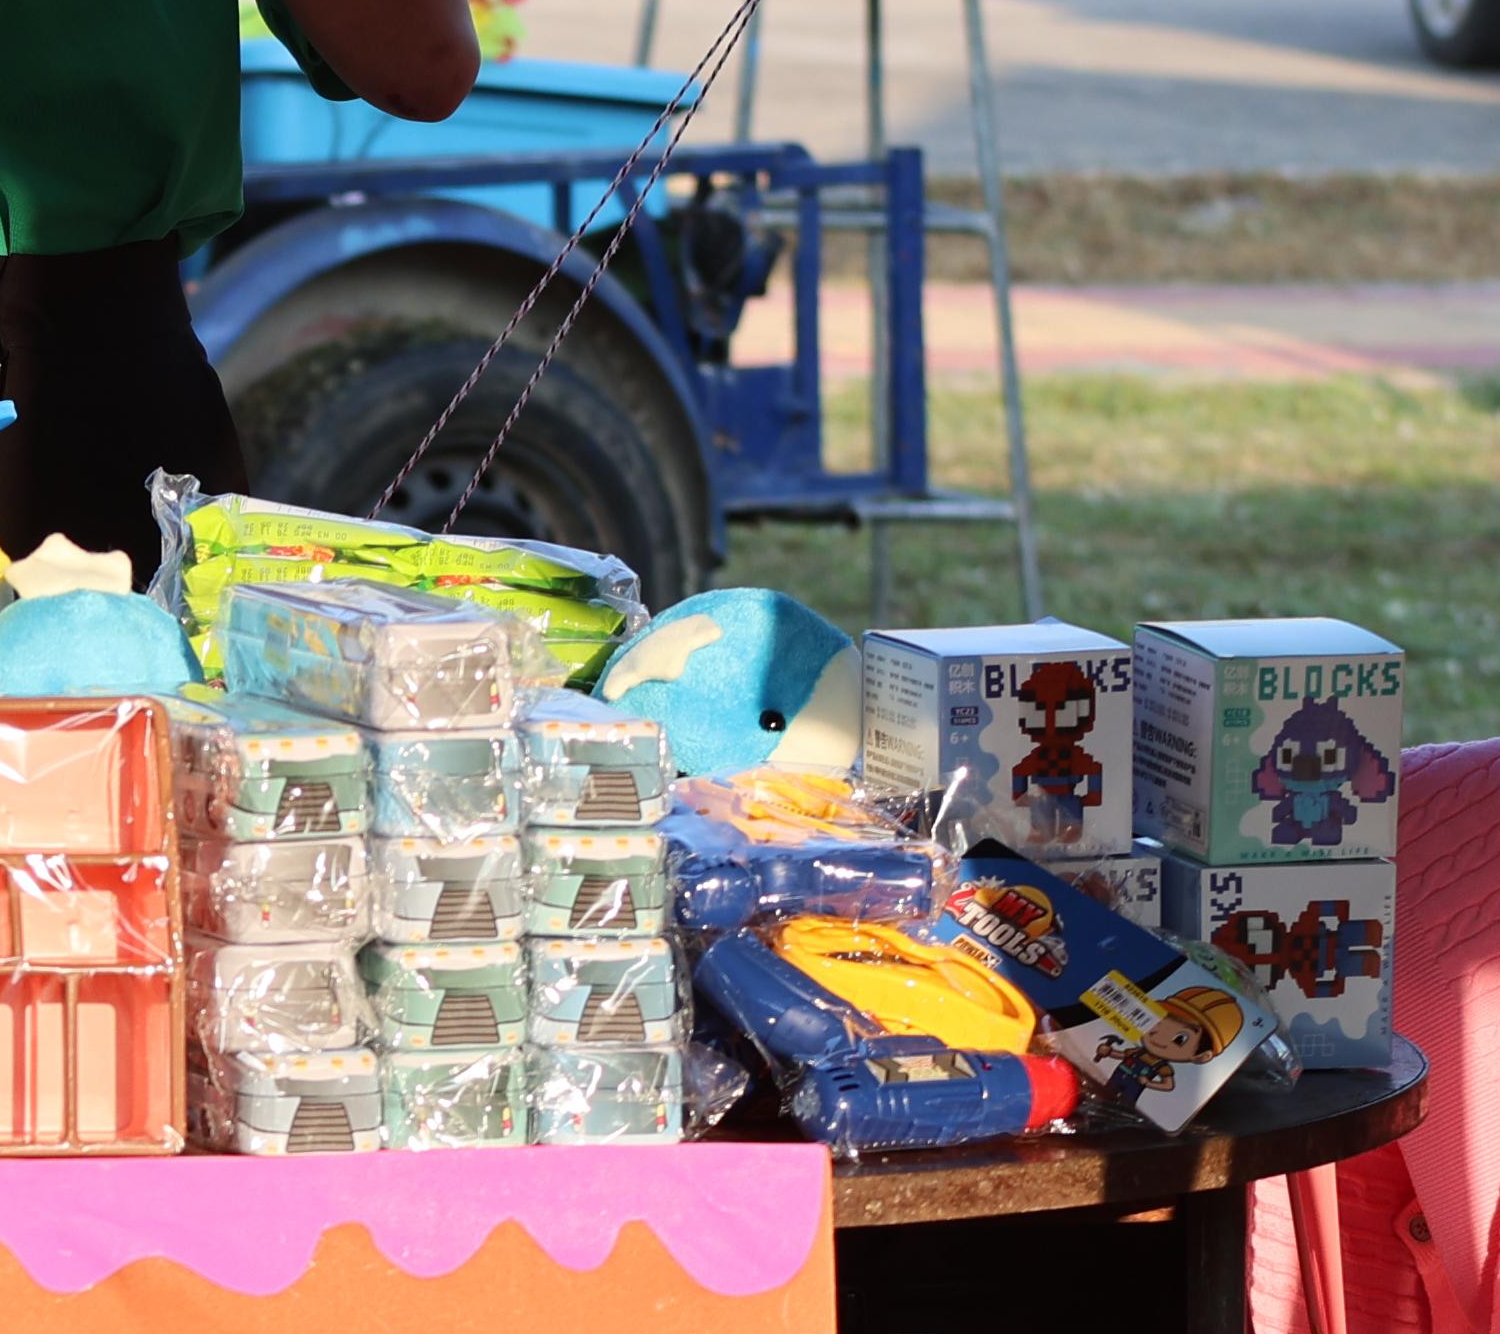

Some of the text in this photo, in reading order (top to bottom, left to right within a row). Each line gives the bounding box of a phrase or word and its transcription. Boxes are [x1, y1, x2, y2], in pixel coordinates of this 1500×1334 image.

[985, 658, 1131, 698] BLKS
[1259, 661, 1401, 700] BLOCKS
[992, 887, 1046, 925] MY
[962, 901, 1046, 967] TOOLS
